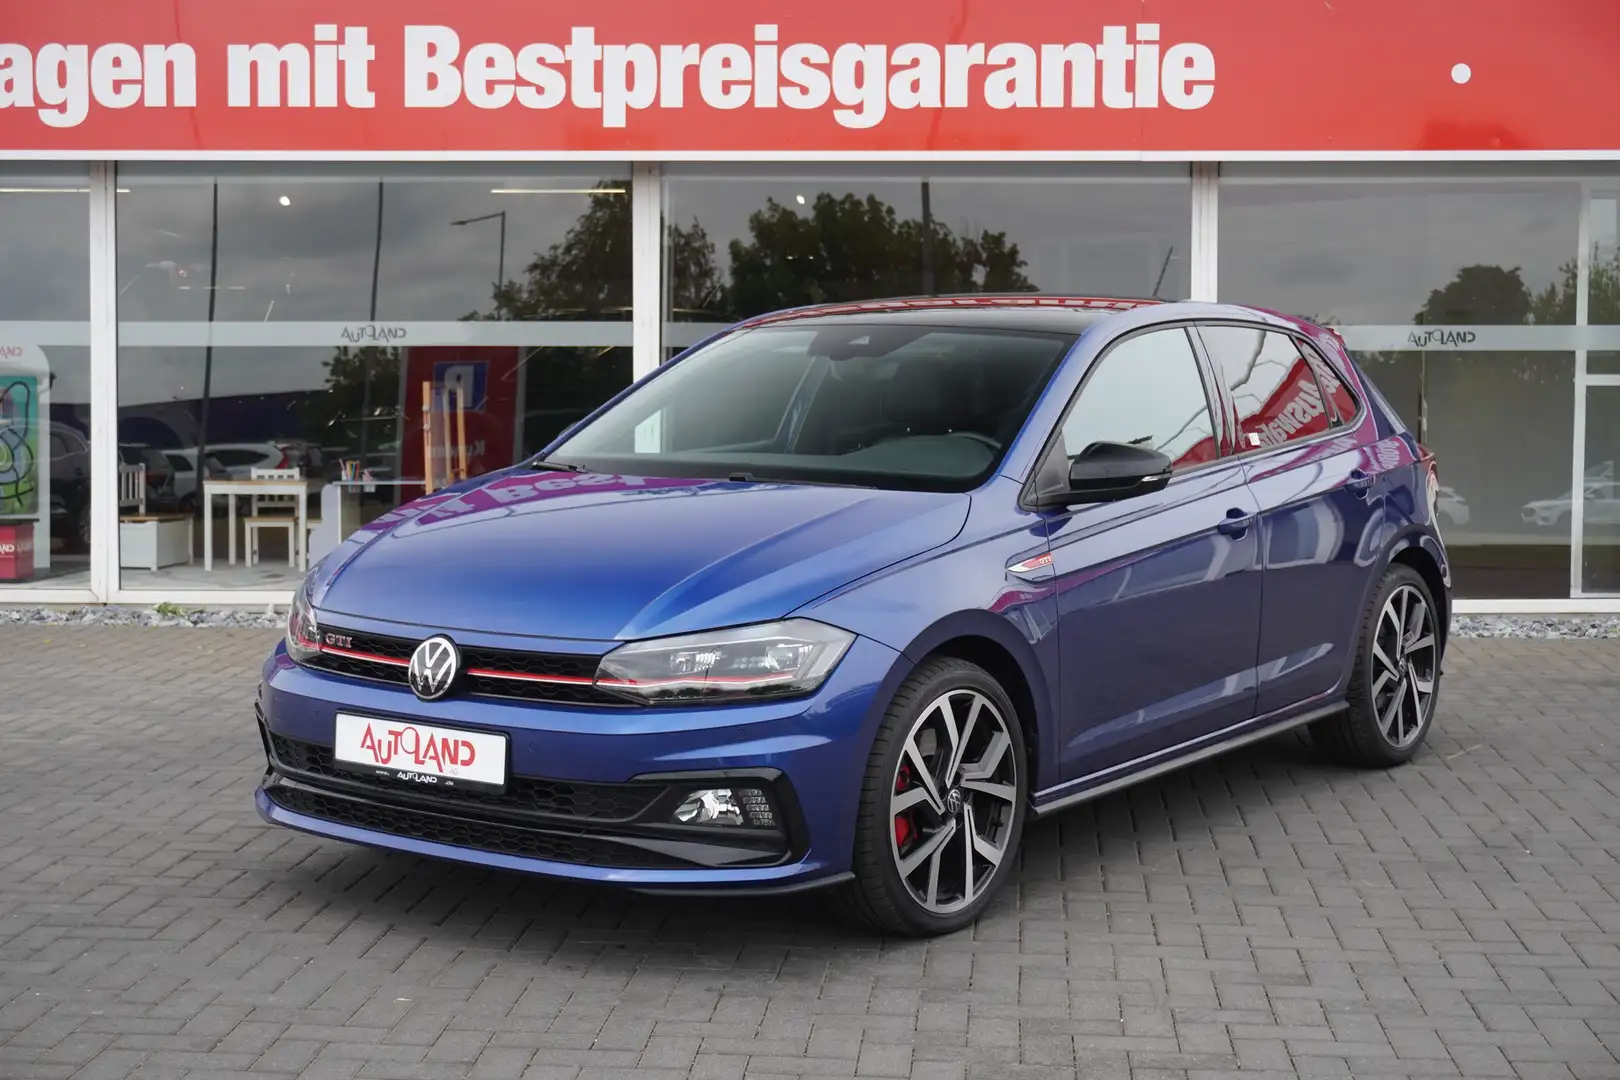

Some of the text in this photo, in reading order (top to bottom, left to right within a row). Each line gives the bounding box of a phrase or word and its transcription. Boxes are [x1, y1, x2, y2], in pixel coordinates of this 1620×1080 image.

[0, 23, 1215, 129] agen mit Bestpreisgarantie
[325, 632, 353, 649] GTI
[360, 722, 476, 773] AUTOLAND
[397, 771, 438, 784] AUTOLAND
